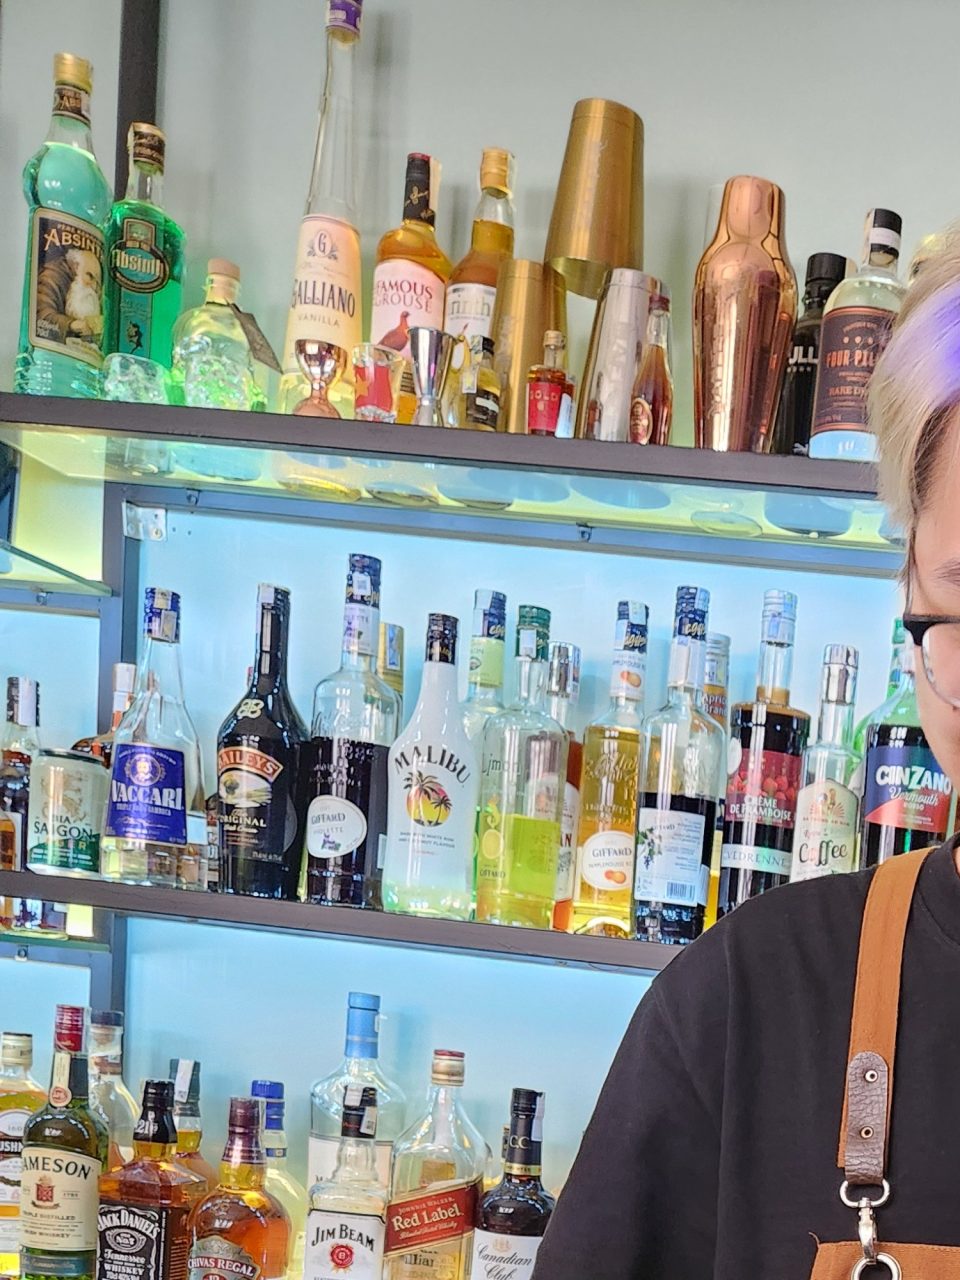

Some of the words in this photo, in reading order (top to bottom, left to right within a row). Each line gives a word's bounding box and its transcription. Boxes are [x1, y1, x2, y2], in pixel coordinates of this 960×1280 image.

[376, 279, 433, 299] FAMOUS
[826, 350, 849, 368] FOUR
[218, 750, 278, 775] BAILEYS
[394, 745, 471, 785] MALIBU
[876, 764, 952, 796] CINZANO
[111, 778, 184, 811] VACCARI
[889, 787, 940, 807] Vermouth
[33, 821, 93, 840] SAGON
[591, 847, 632, 858] GIFFARD
[799, 840, 848, 866] Coffee
[97, 1213, 121, 1232] JACK
[121, 1210, 161, 1239] DANIEL'S
[392, 1213, 421, 1231] Red
[424, 1204, 462, 1223] Label
[311, 1225, 336, 1248] JIM
[339, 1223, 375, 1252] BEAM
[188, 1256, 216, 1269] CHIVAS
[217, 1257, 254, 1277] REGAL
[477, 1242, 534, 1267] Canadian
[104, 1264, 145, 1276] WHISKEY
